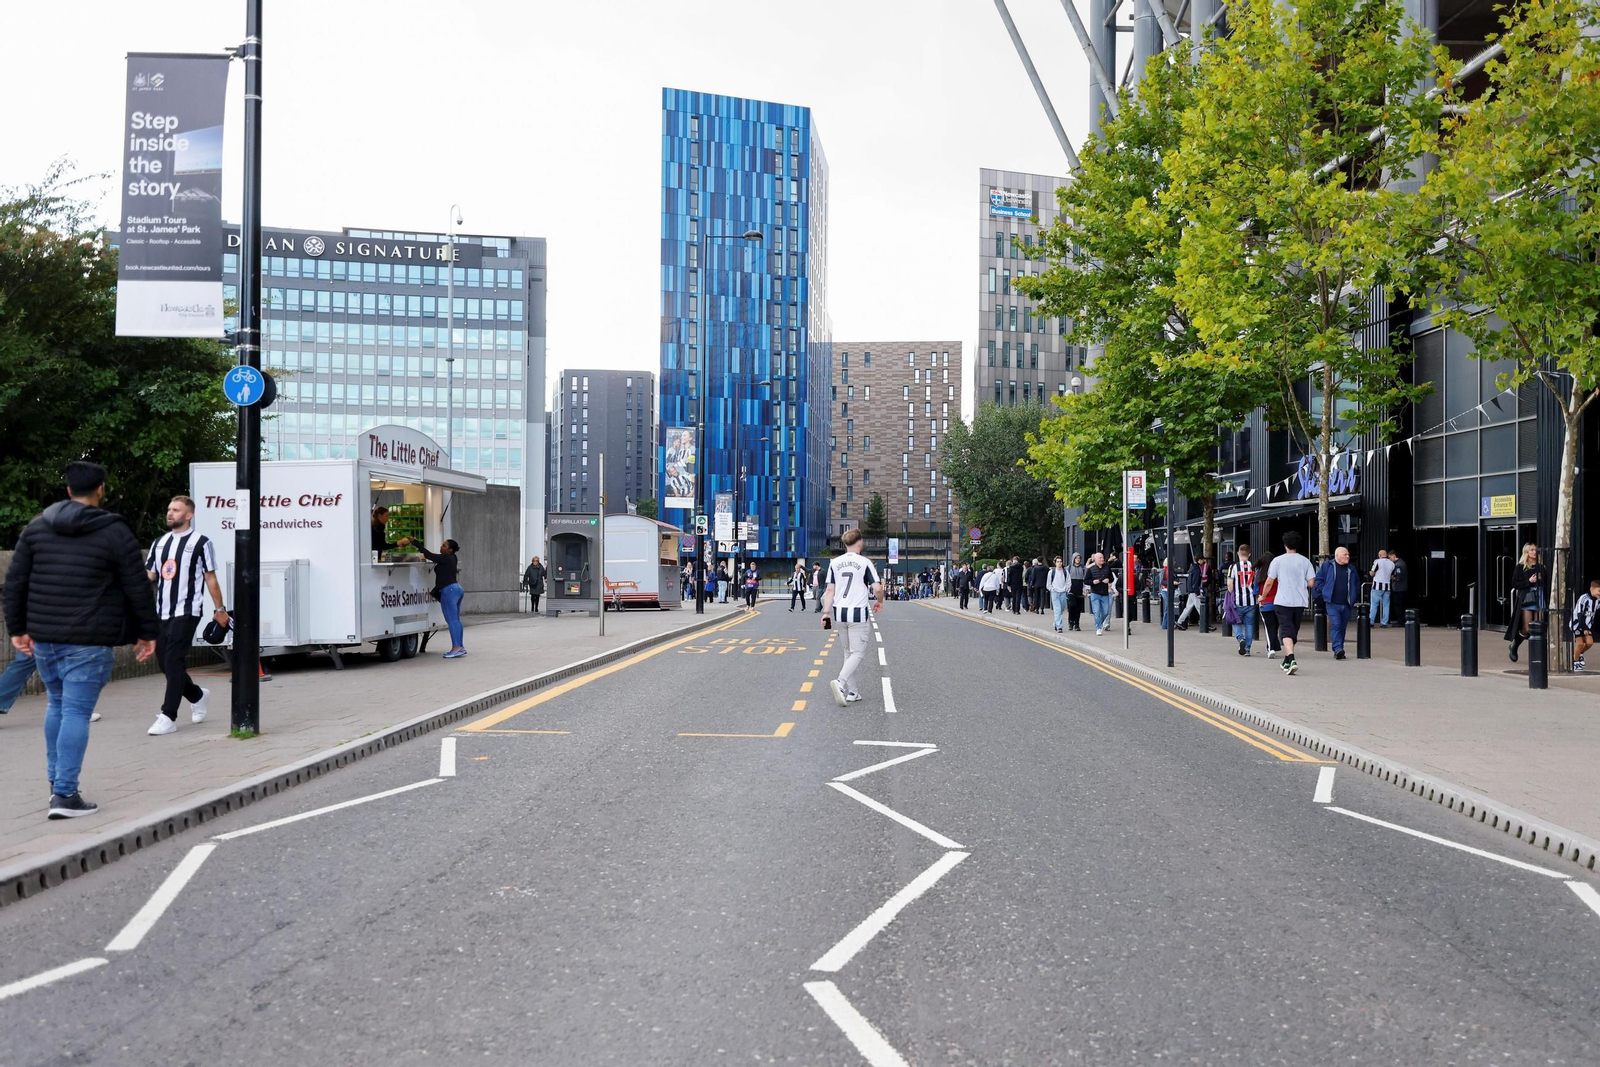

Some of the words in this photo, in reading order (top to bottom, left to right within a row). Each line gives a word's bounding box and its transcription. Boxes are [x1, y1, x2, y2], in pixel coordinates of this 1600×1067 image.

[131, 111, 179, 133] Step
[130, 133, 189, 151] inside
[129, 156, 162, 173] the
[128, 180, 181, 200] story
[127, 216, 161, 224] Stadium
[163, 216, 187, 224] Tours
[991, 208, 1013, 216] Business
[1014, 210, 1031, 218] School
[369, 434, 388, 458] The
[391, 439, 417, 465] Little
[418, 446, 440, 467] Chef
[1134, 477, 1141, 485] B
[205, 495, 236, 508] The
[260, 494, 292, 507] ttle
[298, 493, 342, 508] Chef
[259, 519, 323, 529] andwiches
[837, 561, 862, 571] JOELINTON
[841, 571, 854, 599] 7
[1238, 571, 1255, 588] 17
[381, 591, 401, 608] Steak
[709, 637, 799, 645] BUS
[677, 645, 807, 655] STOP
